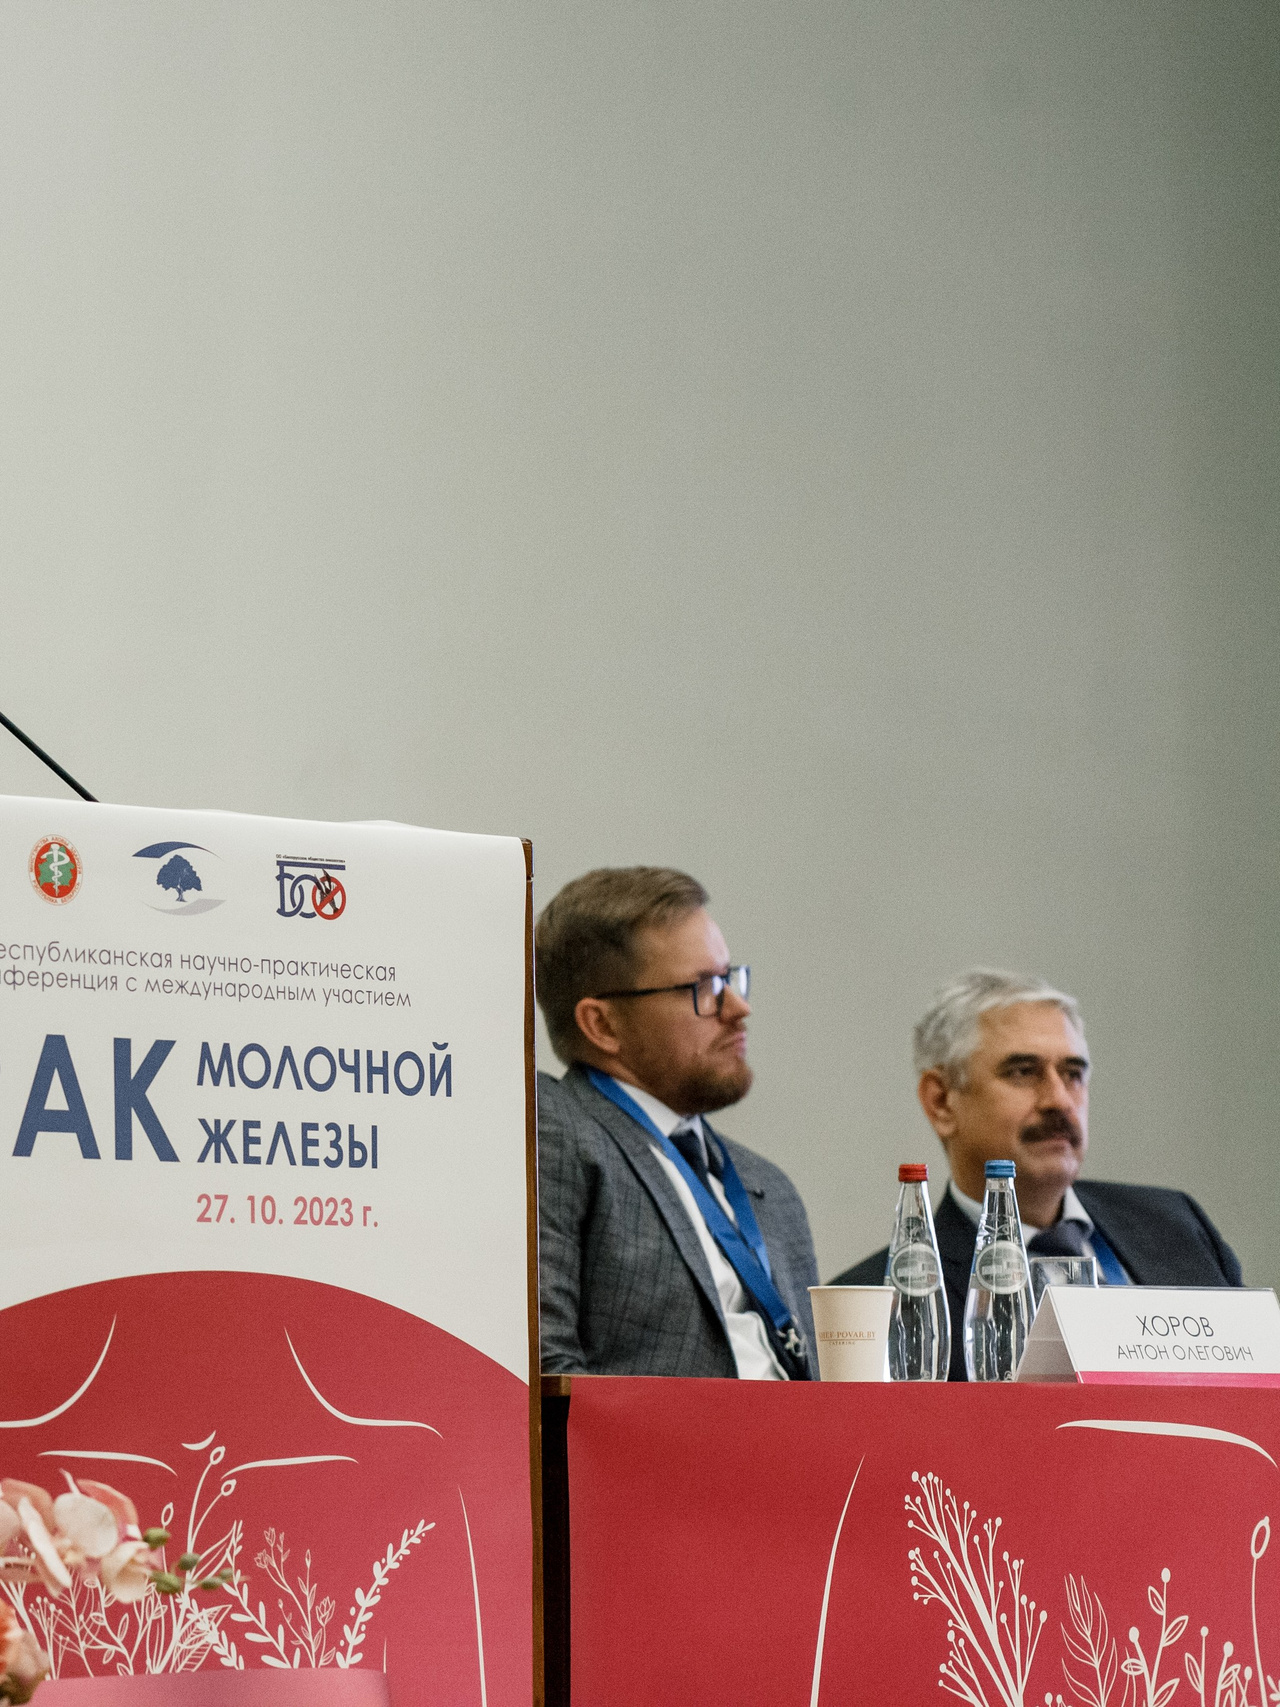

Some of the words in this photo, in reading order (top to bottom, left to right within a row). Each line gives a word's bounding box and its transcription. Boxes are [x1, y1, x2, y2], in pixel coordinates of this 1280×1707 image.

[180, 953, 396, 982] научно-практическая
[125, 976, 138, 992] с
[144, 978, 317, 1003] международным
[322, 987, 412, 1008] участием
[196, 1041, 453, 1098] МОЛОЧНОЙ
[197, 1118, 378, 1169] ЖЕЛЕЗЫ
[196, 1193, 236, 1224] 27.
[246, 1194, 284, 1225] 10.
[293, 1196, 354, 1227] 2023
[362, 1205, 379, 1228] г.
[1135, 1315, 1214, 1338] ХОРОВ
[1117, 1344, 1170, 1361] АНТОН
[1172, 1344, 1254, 1361] ОЛЕГОВИЧ
